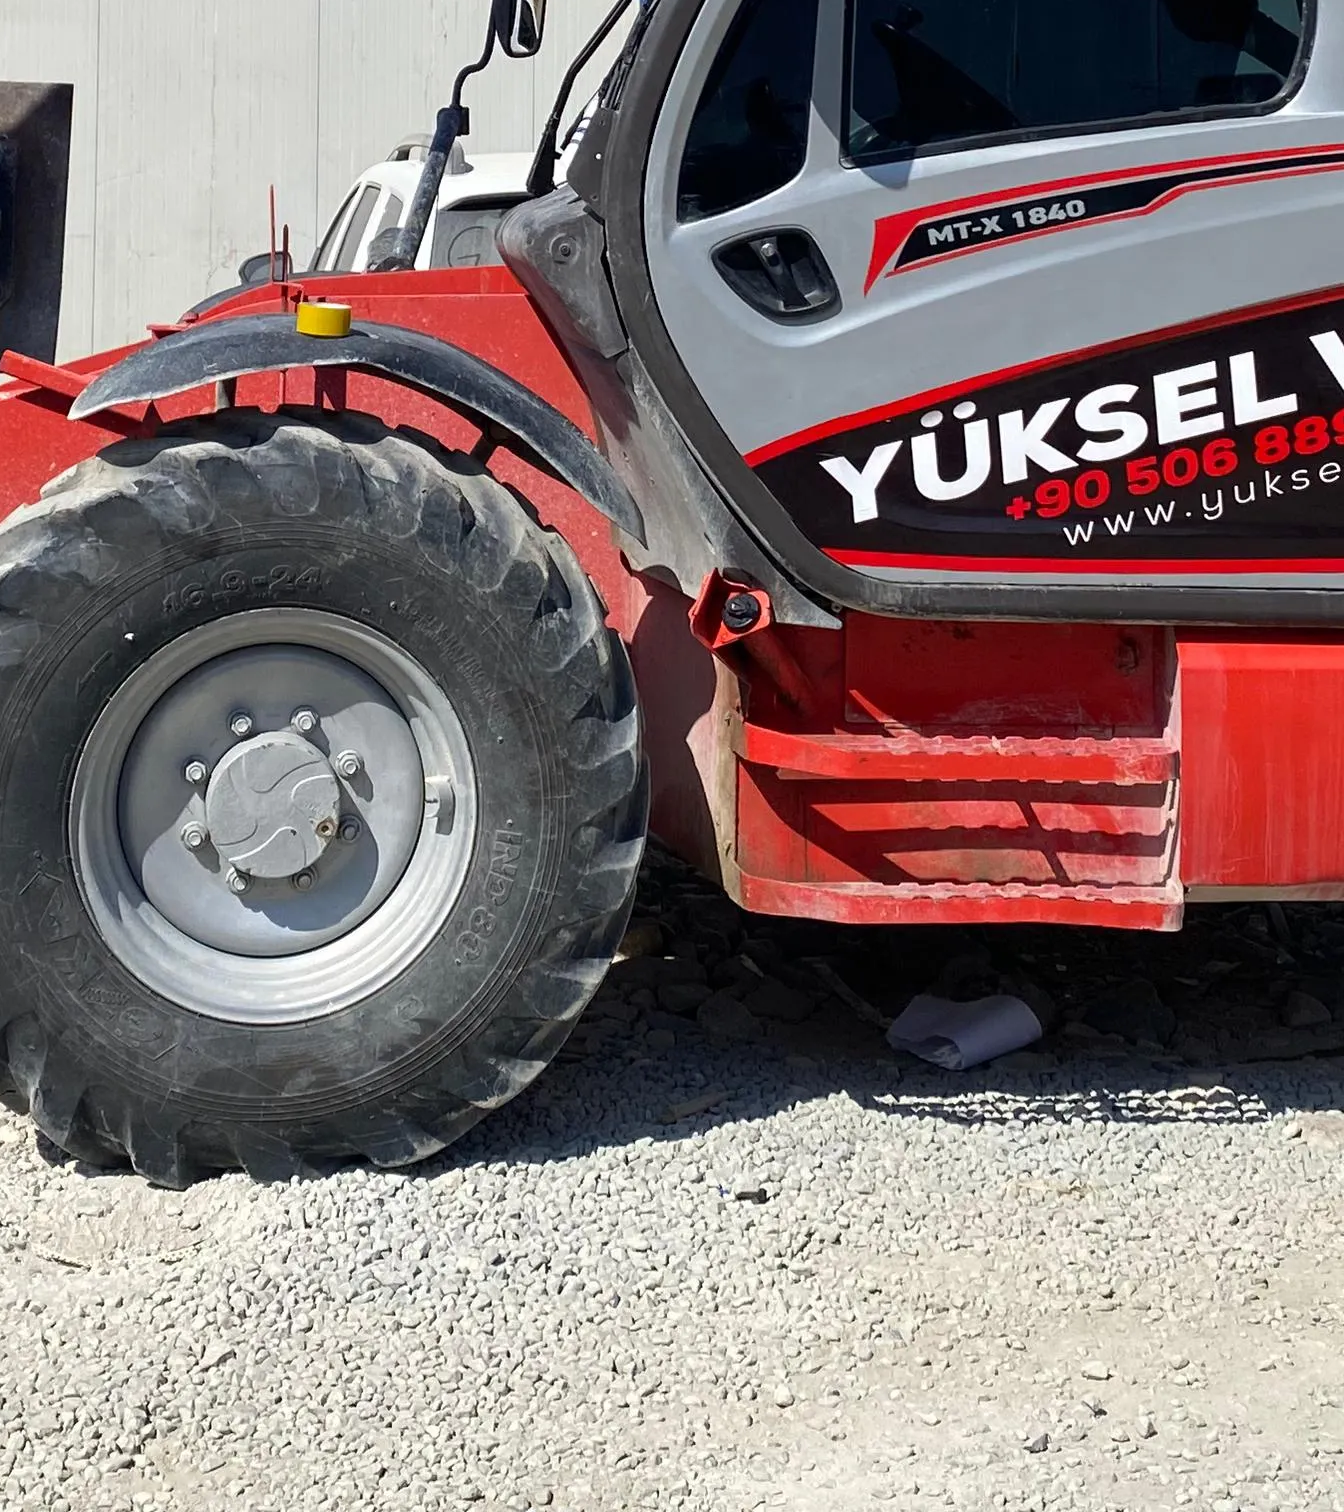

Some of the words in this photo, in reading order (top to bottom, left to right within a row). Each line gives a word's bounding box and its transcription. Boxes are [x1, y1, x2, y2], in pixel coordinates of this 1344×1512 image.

[927, 214, 1004, 246] MT-X
[1011, 199, 1086, 229] 1840
[818, 350, 1298, 524] YÜKSEL
[1005, 469, 1111, 522] +90
[1125, 437, 1240, 496] 506
